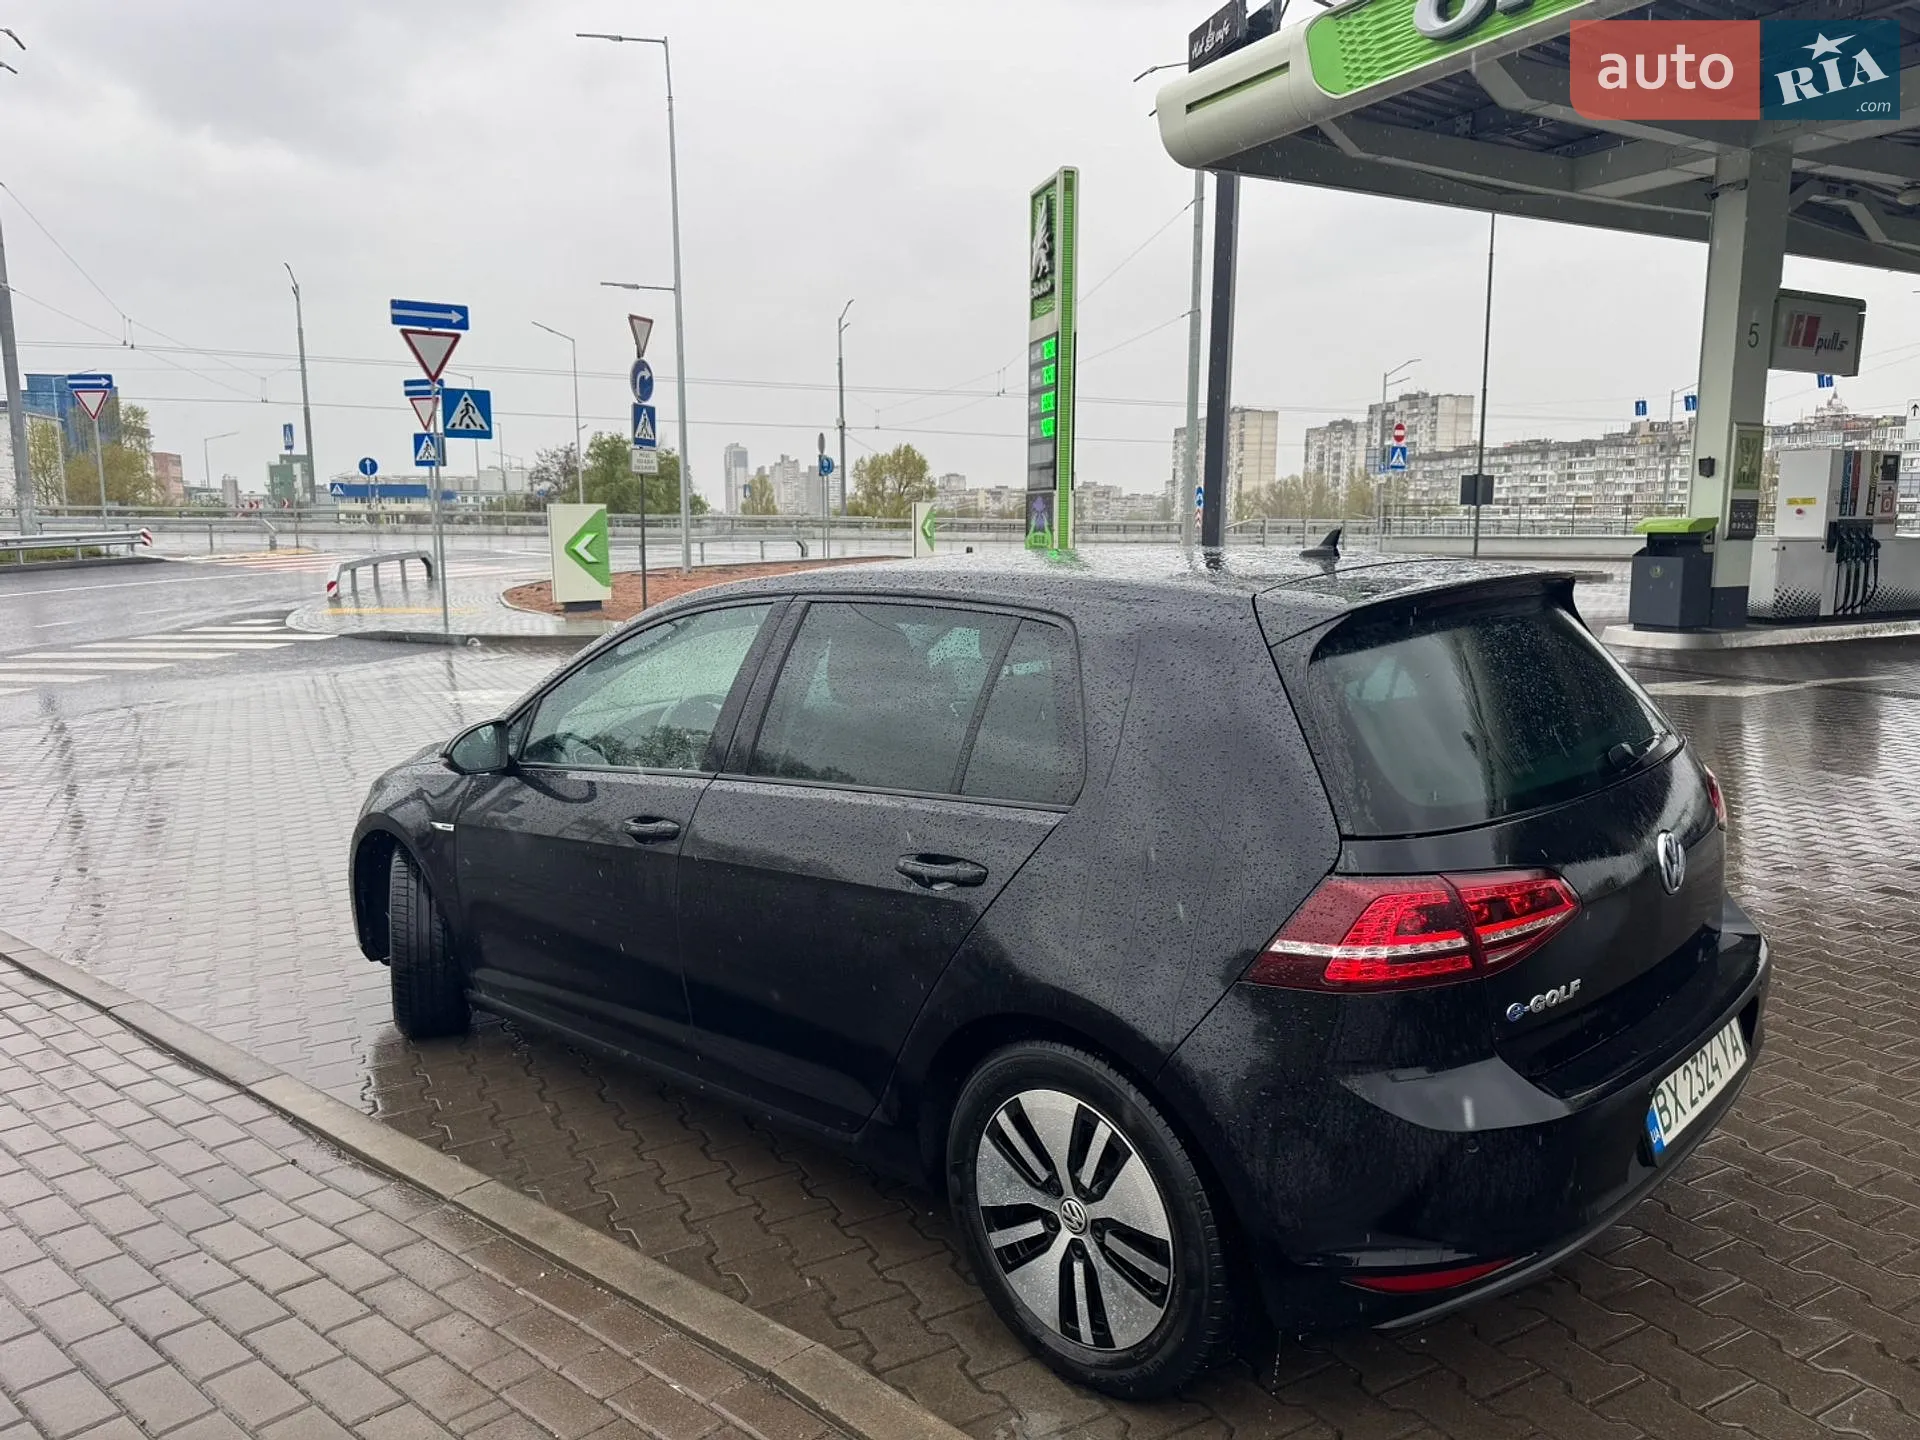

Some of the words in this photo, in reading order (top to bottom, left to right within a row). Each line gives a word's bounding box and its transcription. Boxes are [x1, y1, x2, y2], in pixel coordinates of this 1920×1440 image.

[1748, 323, 1759, 348] 5
[1814, 332, 1848, 356] pulls
[1506, 979, 1581, 1022] e-GOLF
[1655, 1073, 1687, 1134] BX
[1683, 1041, 1722, 1108] 2324
[1718, 1024, 1742, 1069] YA
